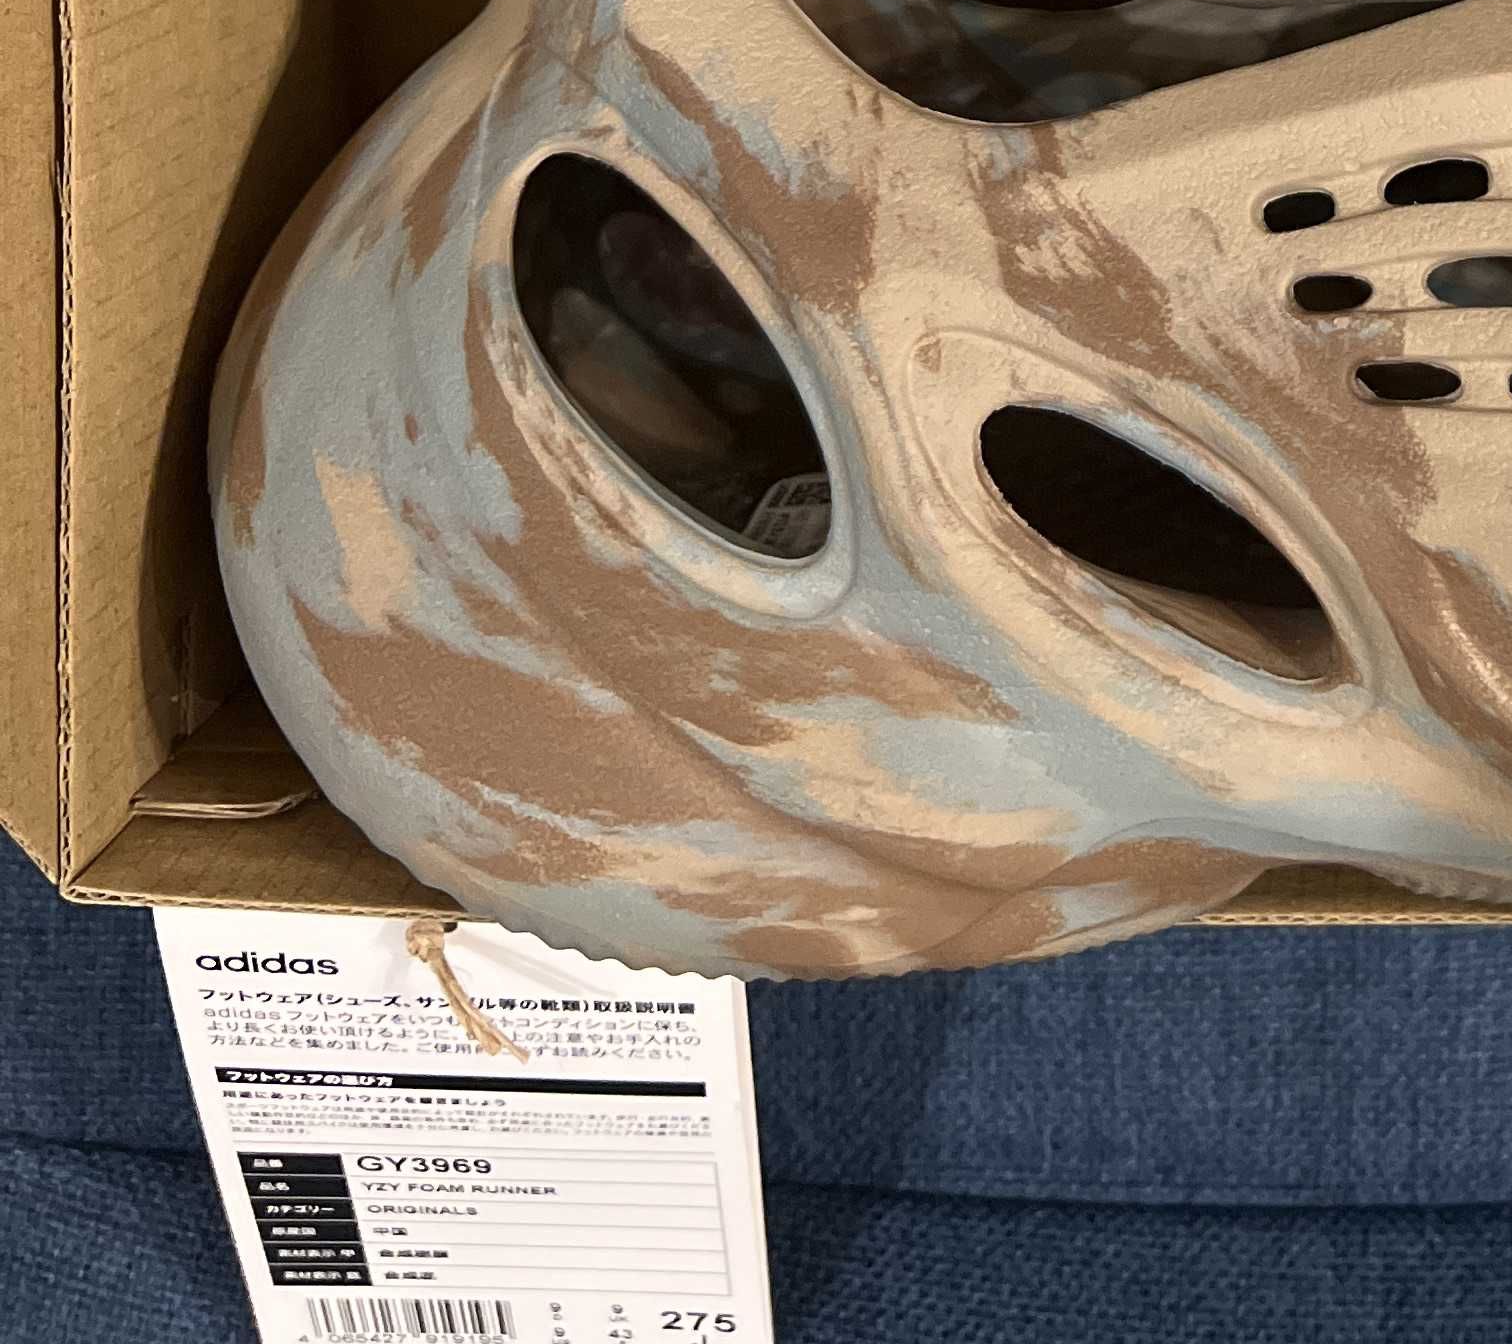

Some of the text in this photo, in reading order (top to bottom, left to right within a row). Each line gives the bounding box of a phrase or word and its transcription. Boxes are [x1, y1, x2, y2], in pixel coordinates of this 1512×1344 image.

[195, 951, 340, 975] adidas
[198, 988, 696, 1015] フットウェア(シューズ、サンル等の靴類)取扱説明書
[204, 1006, 281, 1022] adidas
[356, 1155, 493, 1175] GY3969
[361, 1181, 557, 1196] YZY FOAM RUNNER
[265, 1203, 336, 1215] カテゴリー
[366, 1203, 478, 1216] ORIGINALS
[660, 1310, 737, 1333] 275
[328, 1333, 407, 1344] 065427
[607, 1328, 633, 1340] 43
